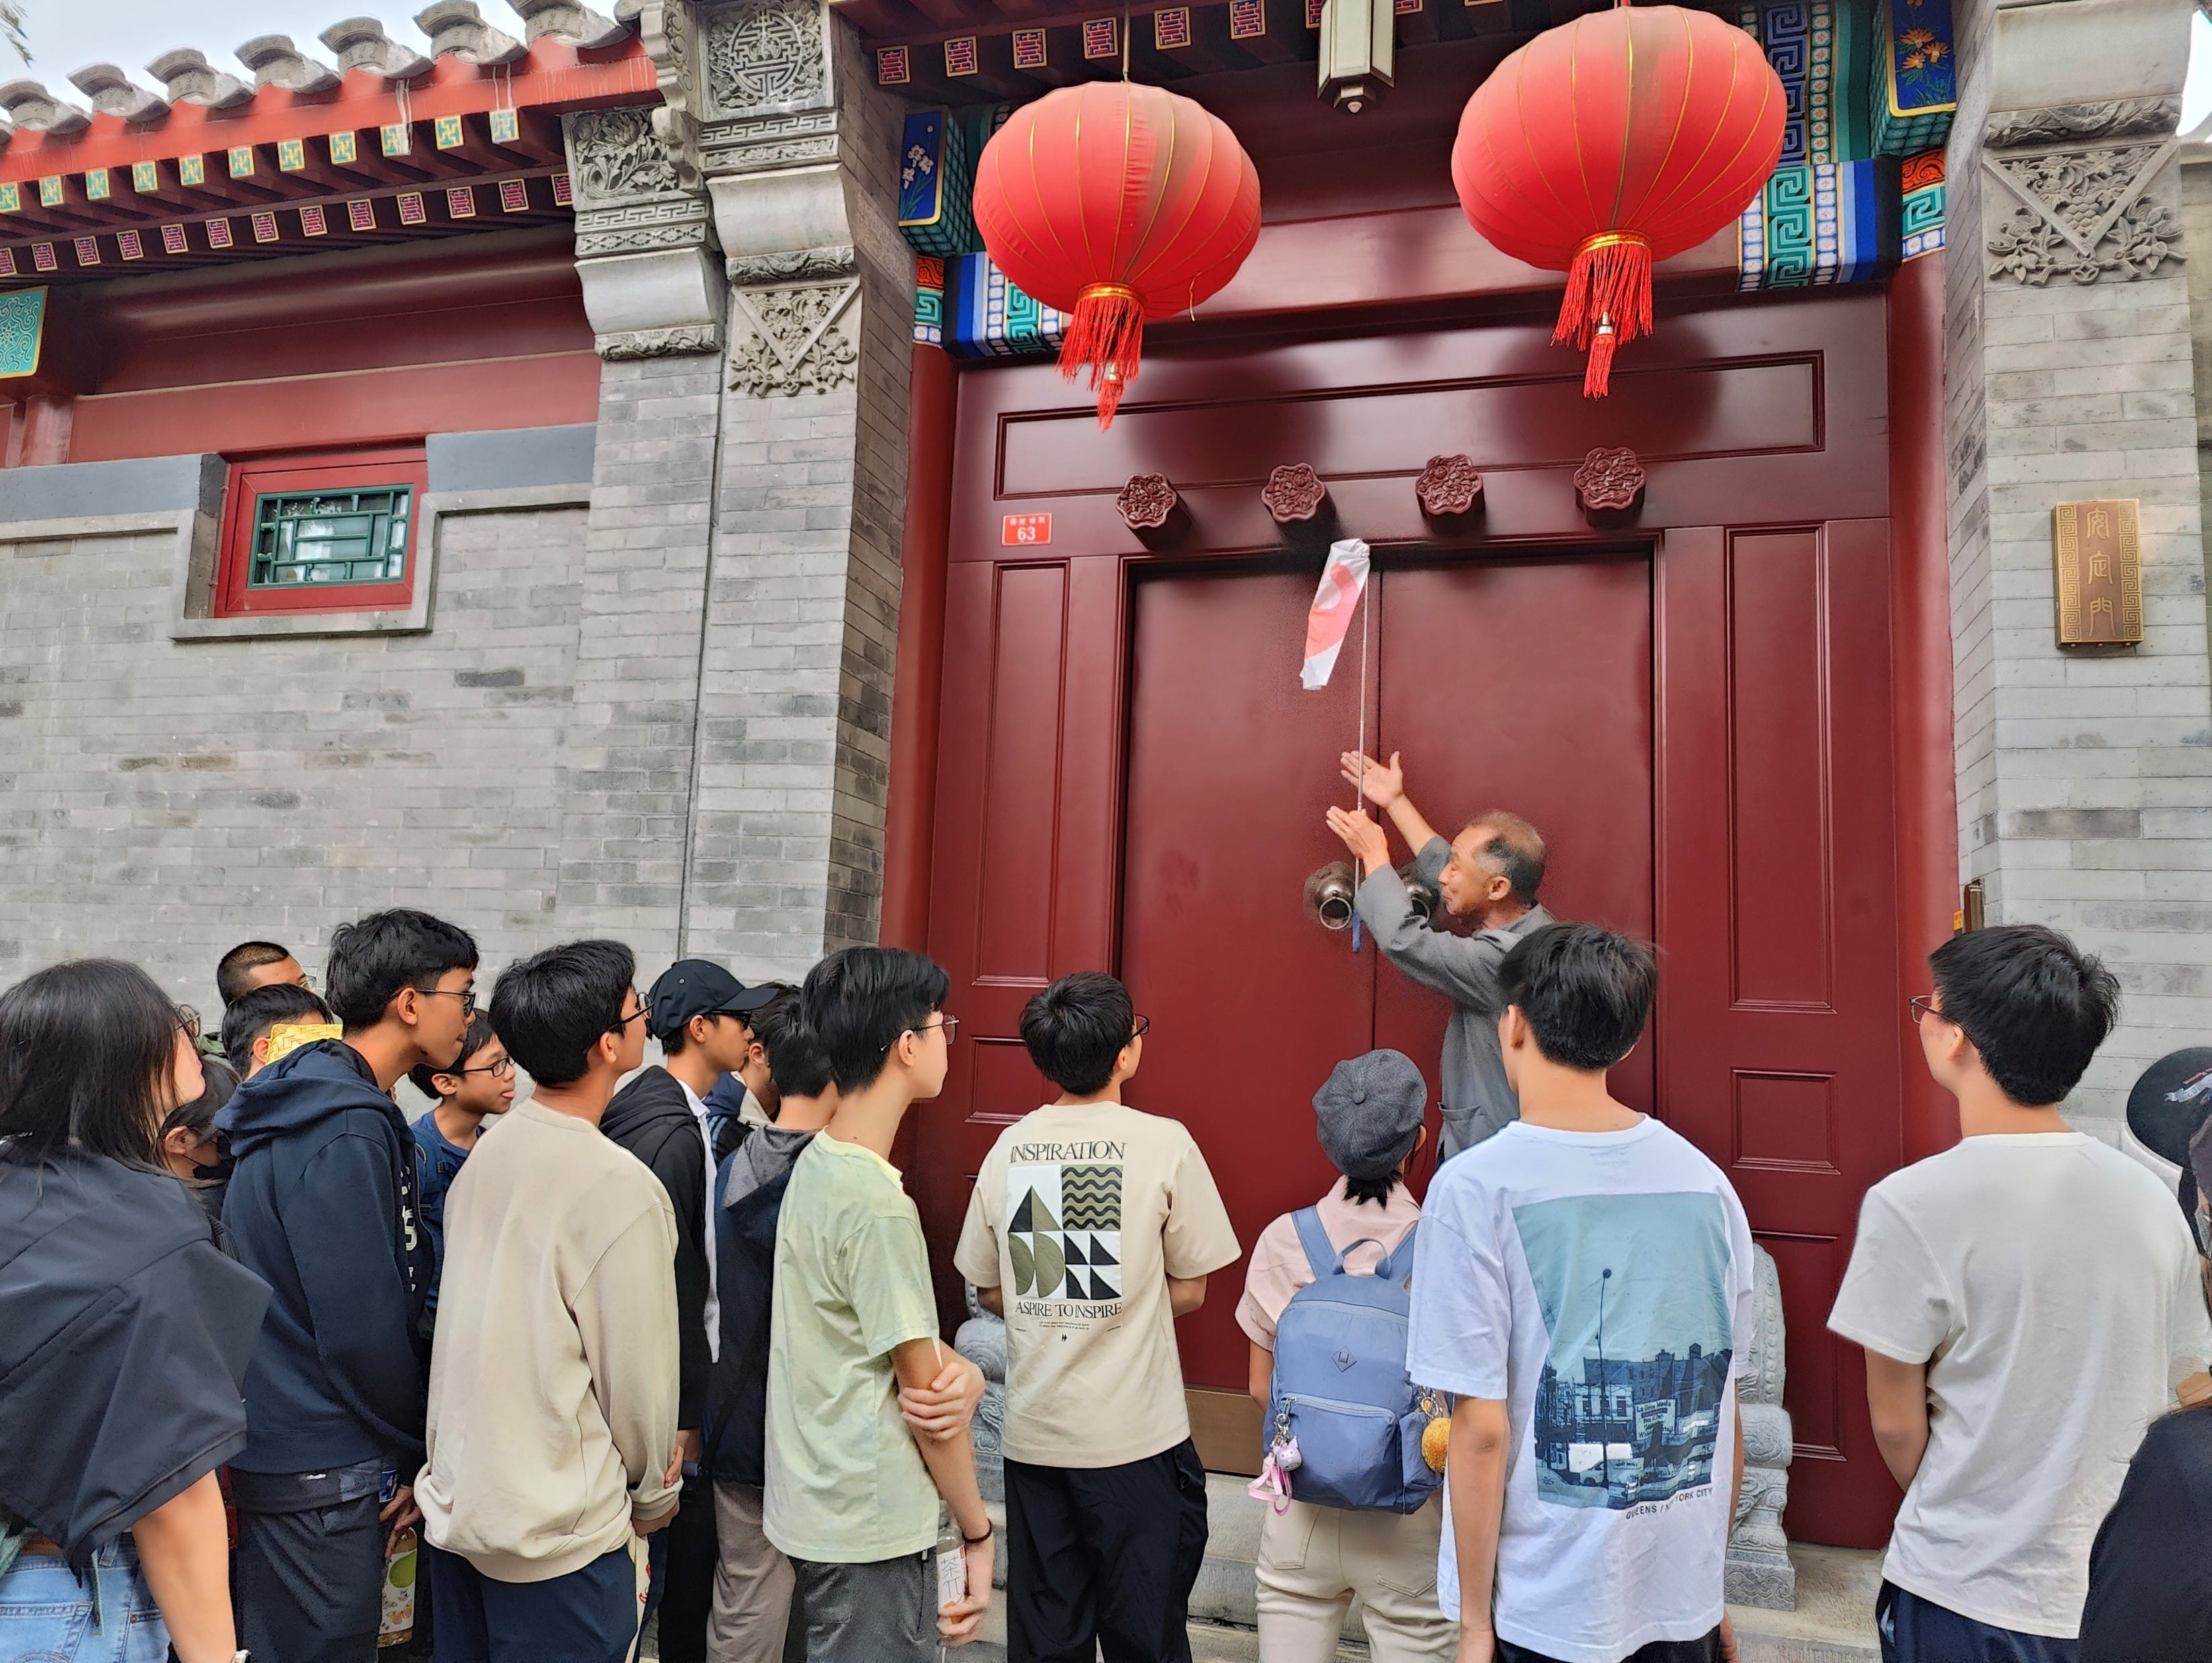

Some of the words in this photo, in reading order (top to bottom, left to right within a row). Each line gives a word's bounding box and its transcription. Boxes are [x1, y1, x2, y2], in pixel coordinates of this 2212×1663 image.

[1017, 526, 1036, 540] 63
[1010, 1140, 1128, 1163] INSPIRATION
[1015, 1301, 1052, 1317] ASPIRE
[1055, 1304, 1074, 1317] TO
[1075, 1302, 1122, 1319] INSPIRE
[1675, 1491, 1693, 1502] YORK
[1696, 1486, 1713, 1498] CITY
